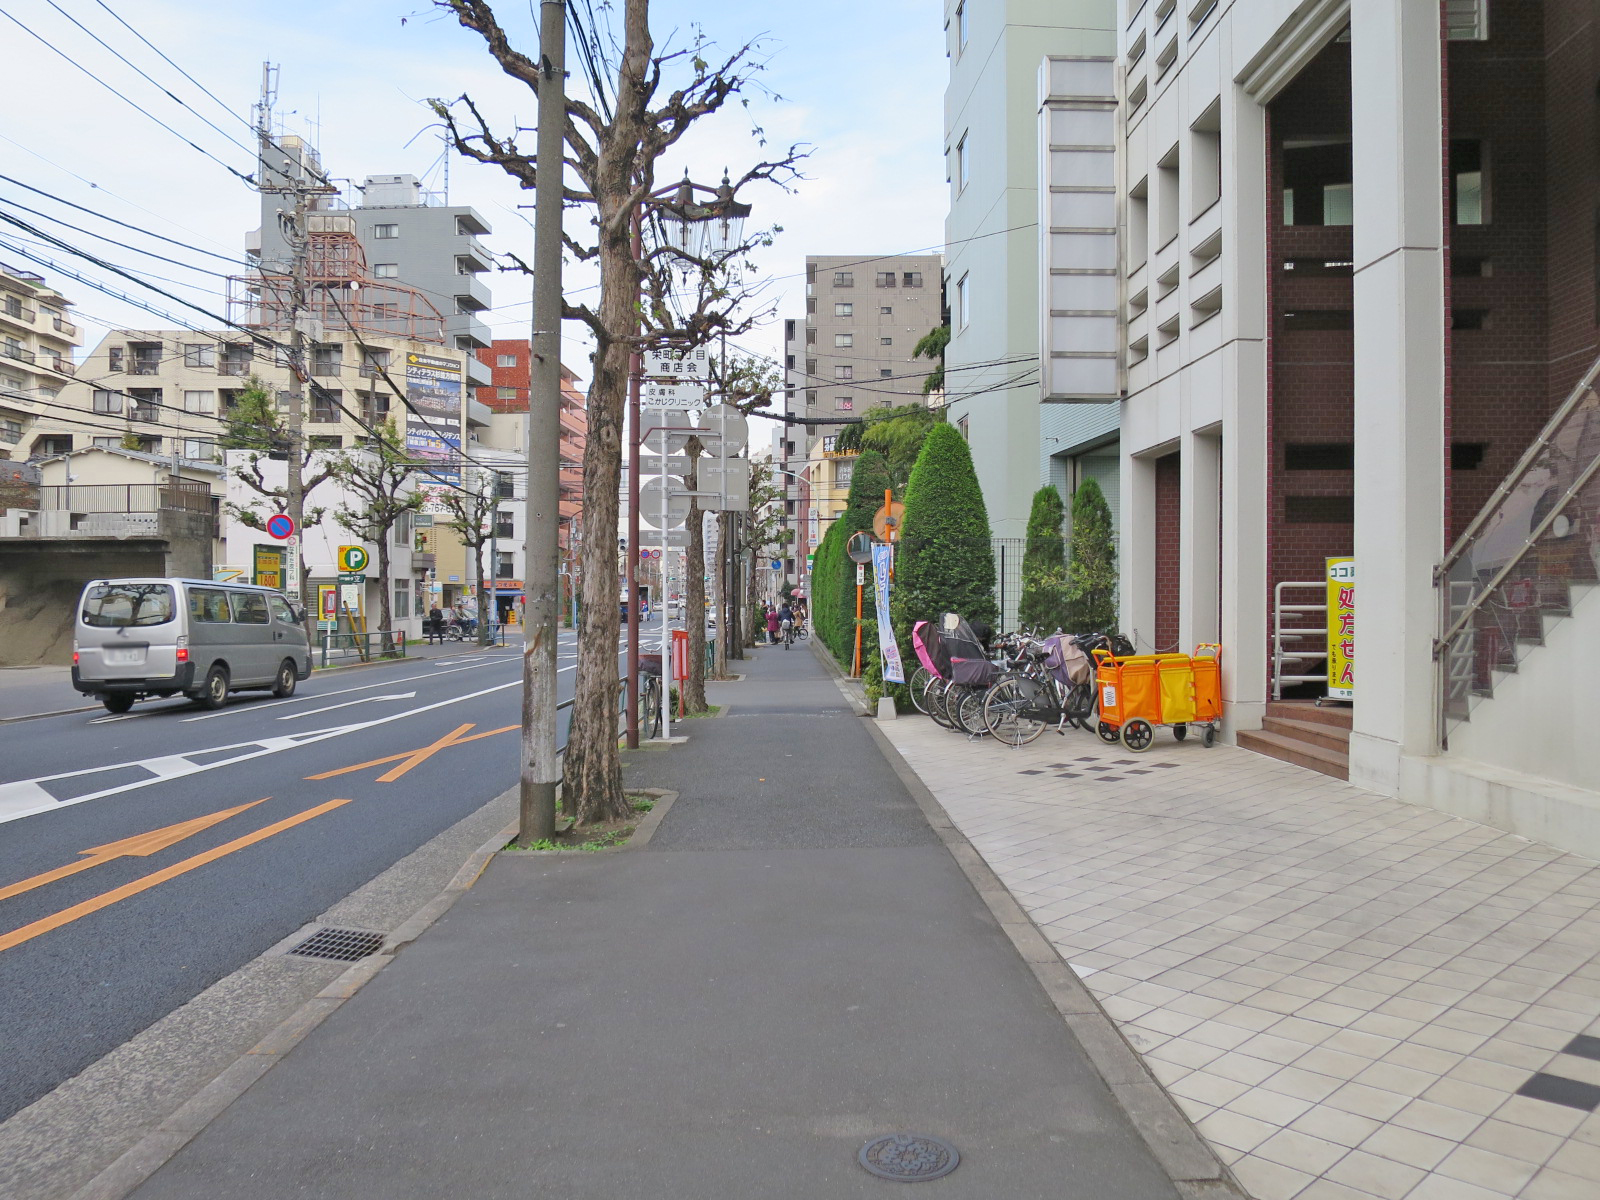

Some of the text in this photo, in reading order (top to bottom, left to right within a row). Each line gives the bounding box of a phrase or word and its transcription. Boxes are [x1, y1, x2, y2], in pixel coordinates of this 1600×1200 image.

[660, 362, 697, 372] 商店会
[648, 388, 675, 397] 皮膚科
[648, 397, 701, 406] こかじクリニック
[350, 550, 362, 567] P
[1338, 586, 1354, 684] 処方せん
